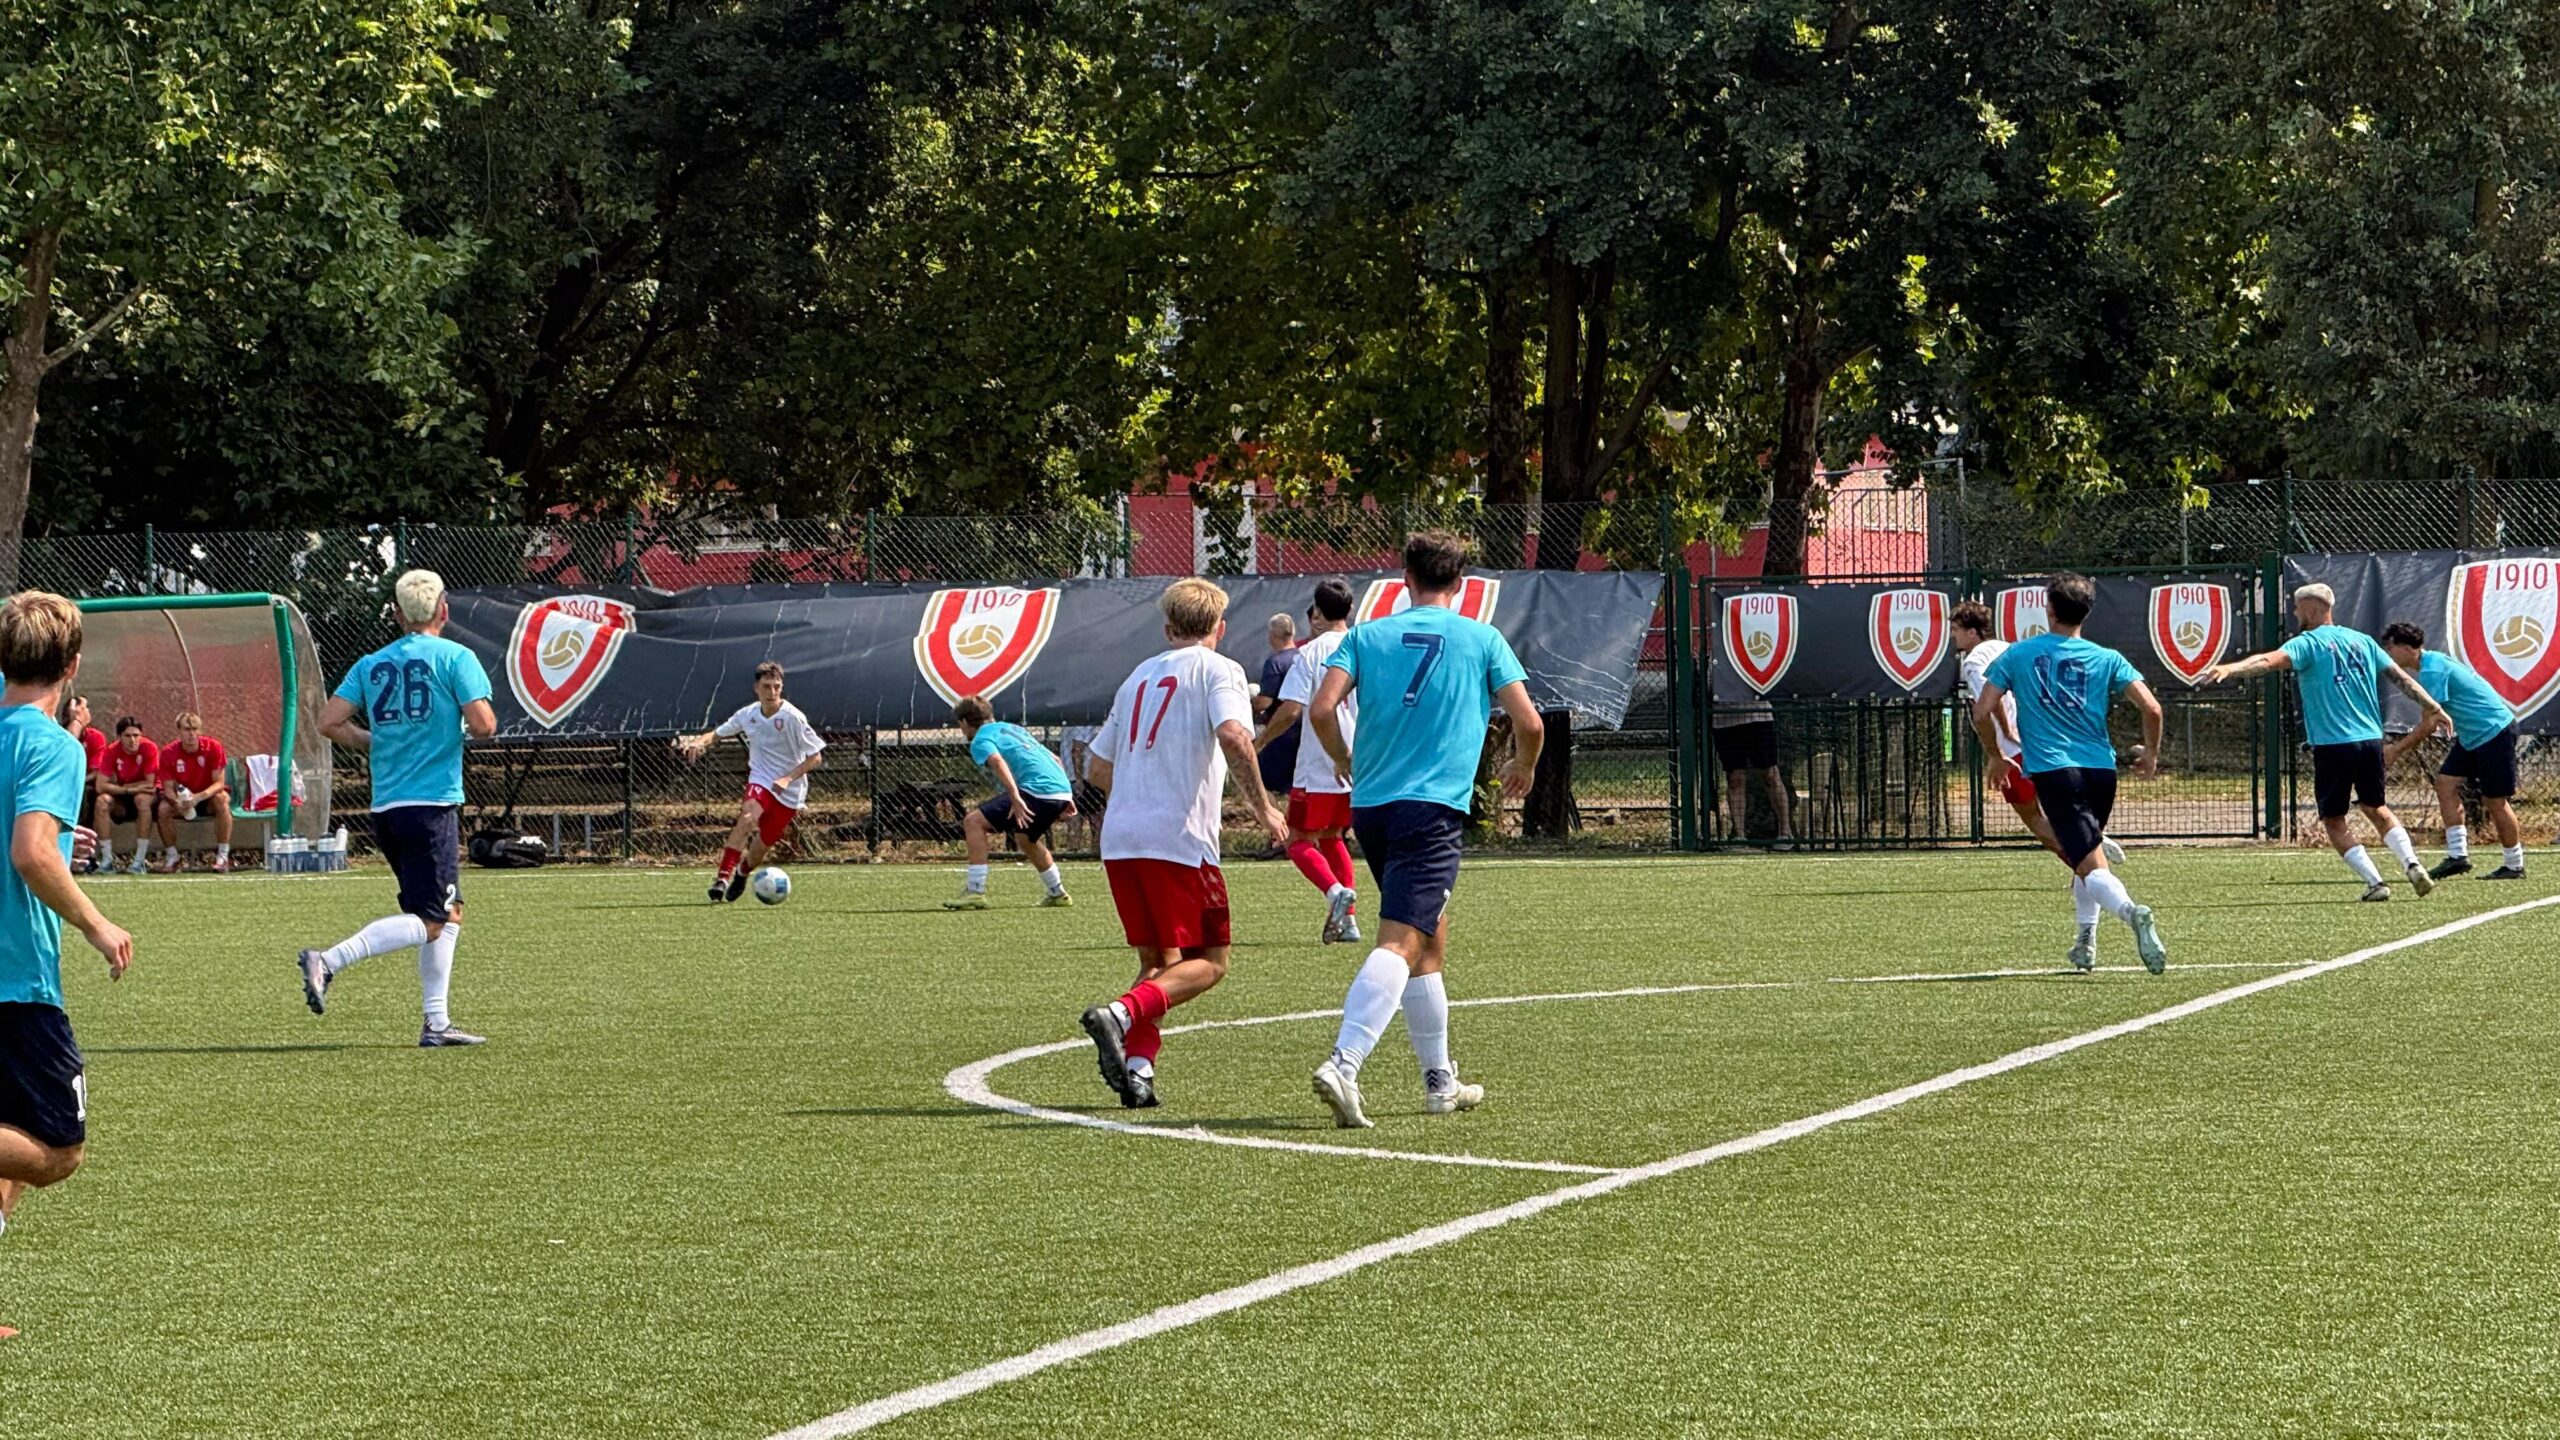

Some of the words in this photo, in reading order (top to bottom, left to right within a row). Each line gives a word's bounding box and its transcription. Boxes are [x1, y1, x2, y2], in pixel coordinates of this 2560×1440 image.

[2496, 563, 2548, 591] 1910
[972, 589, 1023, 614] 1910
[1745, 596, 1774, 615] 1910
[1895, 592, 1925, 611] 1910
[2176, 586, 2205, 605] 1910
[1402, 632, 1446, 707] 7
[370, 659, 435, 726] 26
[1129, 675, 1178, 753] 17
